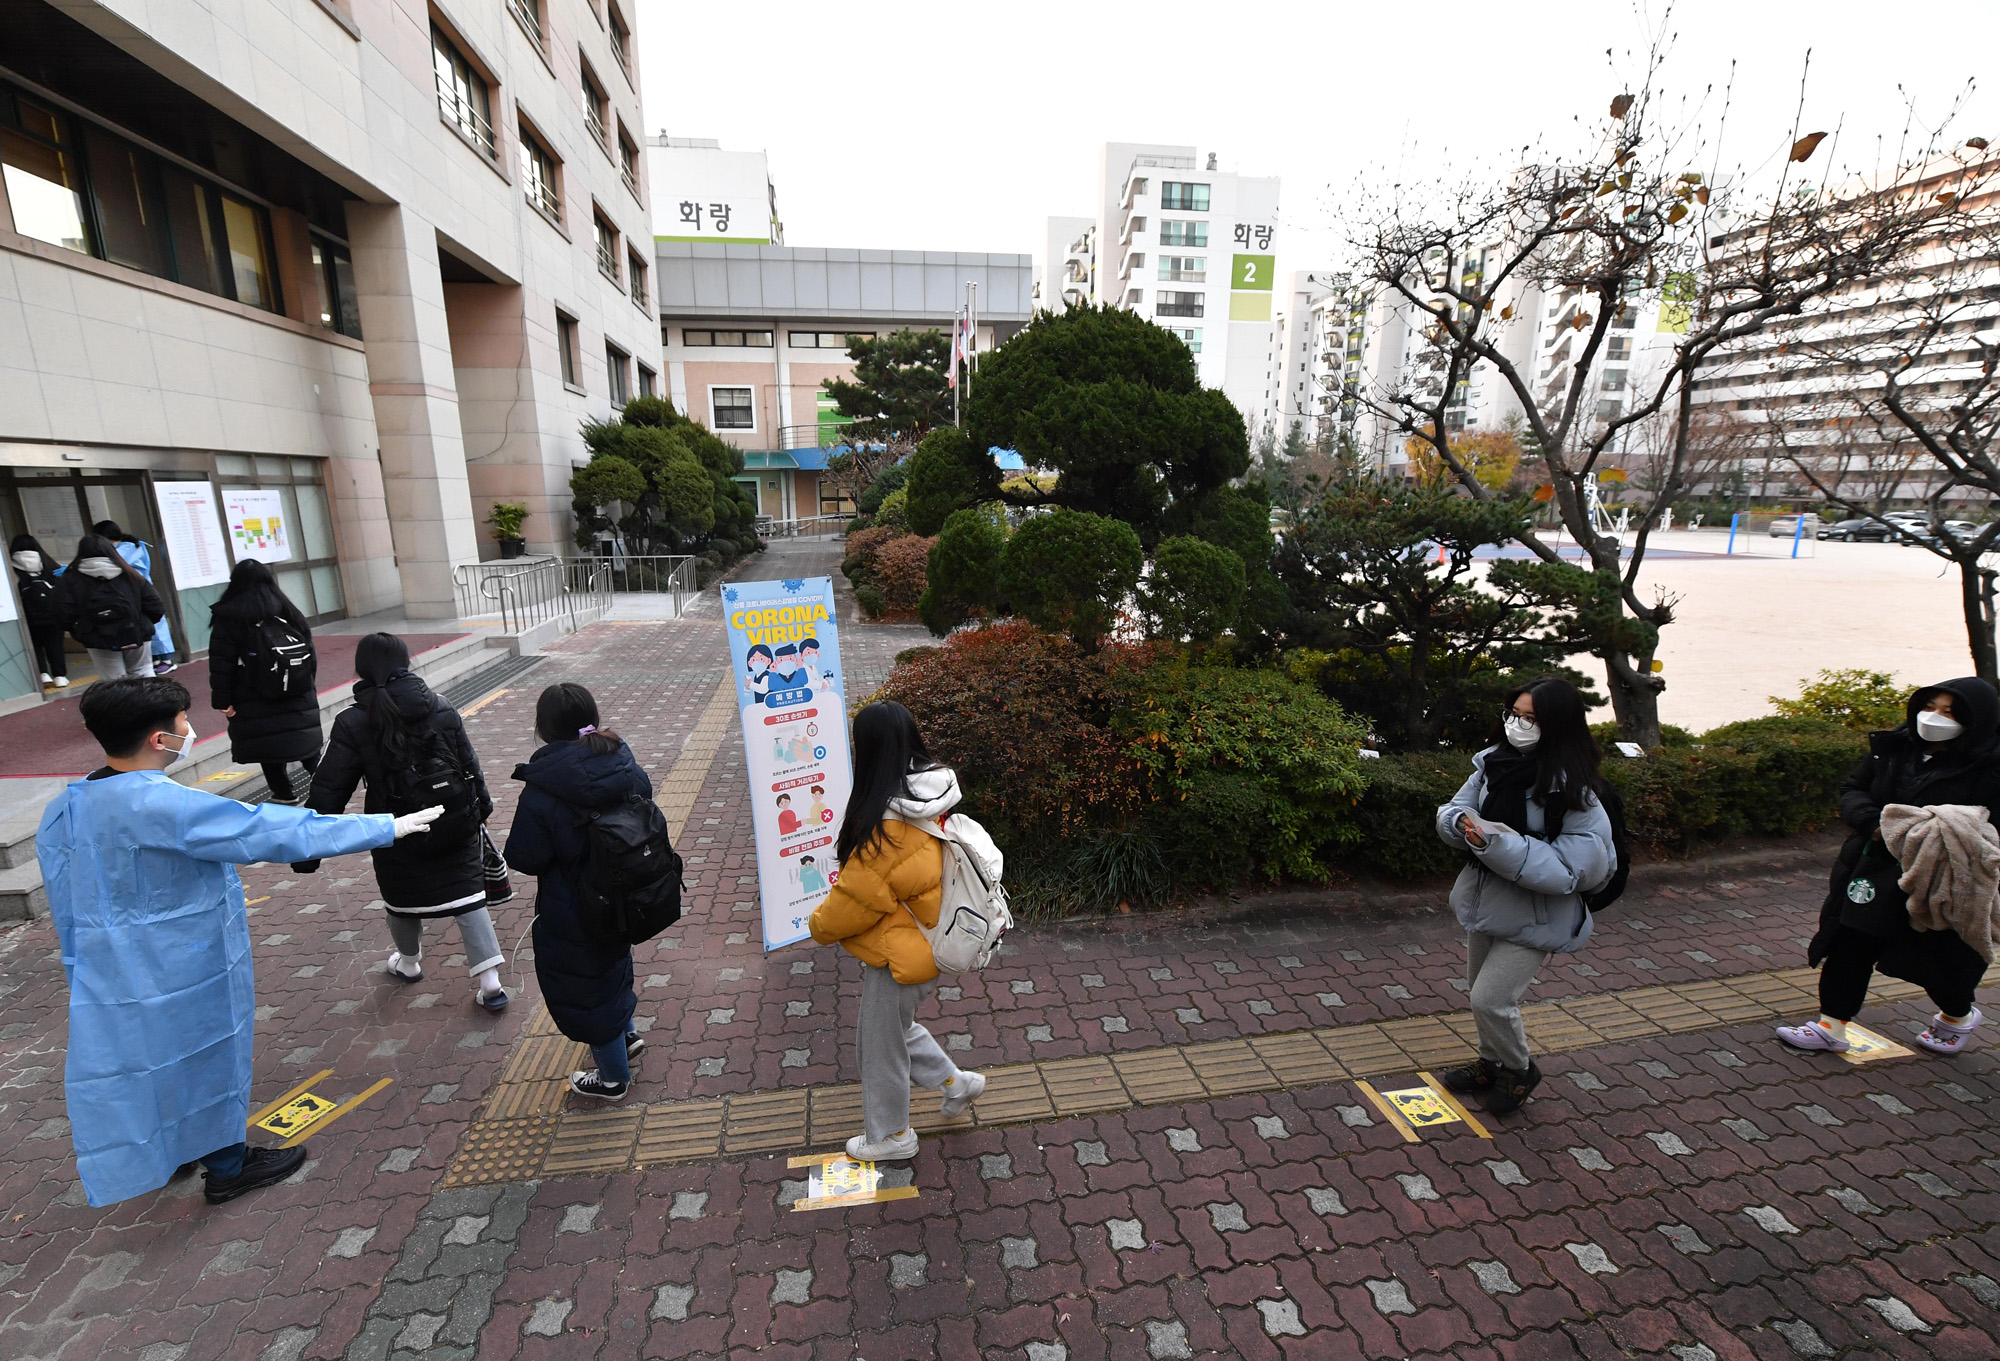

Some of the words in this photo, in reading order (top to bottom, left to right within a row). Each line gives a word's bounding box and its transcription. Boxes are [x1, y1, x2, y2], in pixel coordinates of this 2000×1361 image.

[679, 200, 732, 233] 화랑
[1233, 223, 1275, 250] 화랑
[1243, 262, 1257, 283] 2
[731, 604, 829, 629] CORONA
[746, 623, 817, 646] VIRUS
[775, 714, 790, 723] 30초
[778, 780, 796, 790] 사회적
[797, 774, 819, 786] 거리두기
[814, 838, 825, 847] 주의
